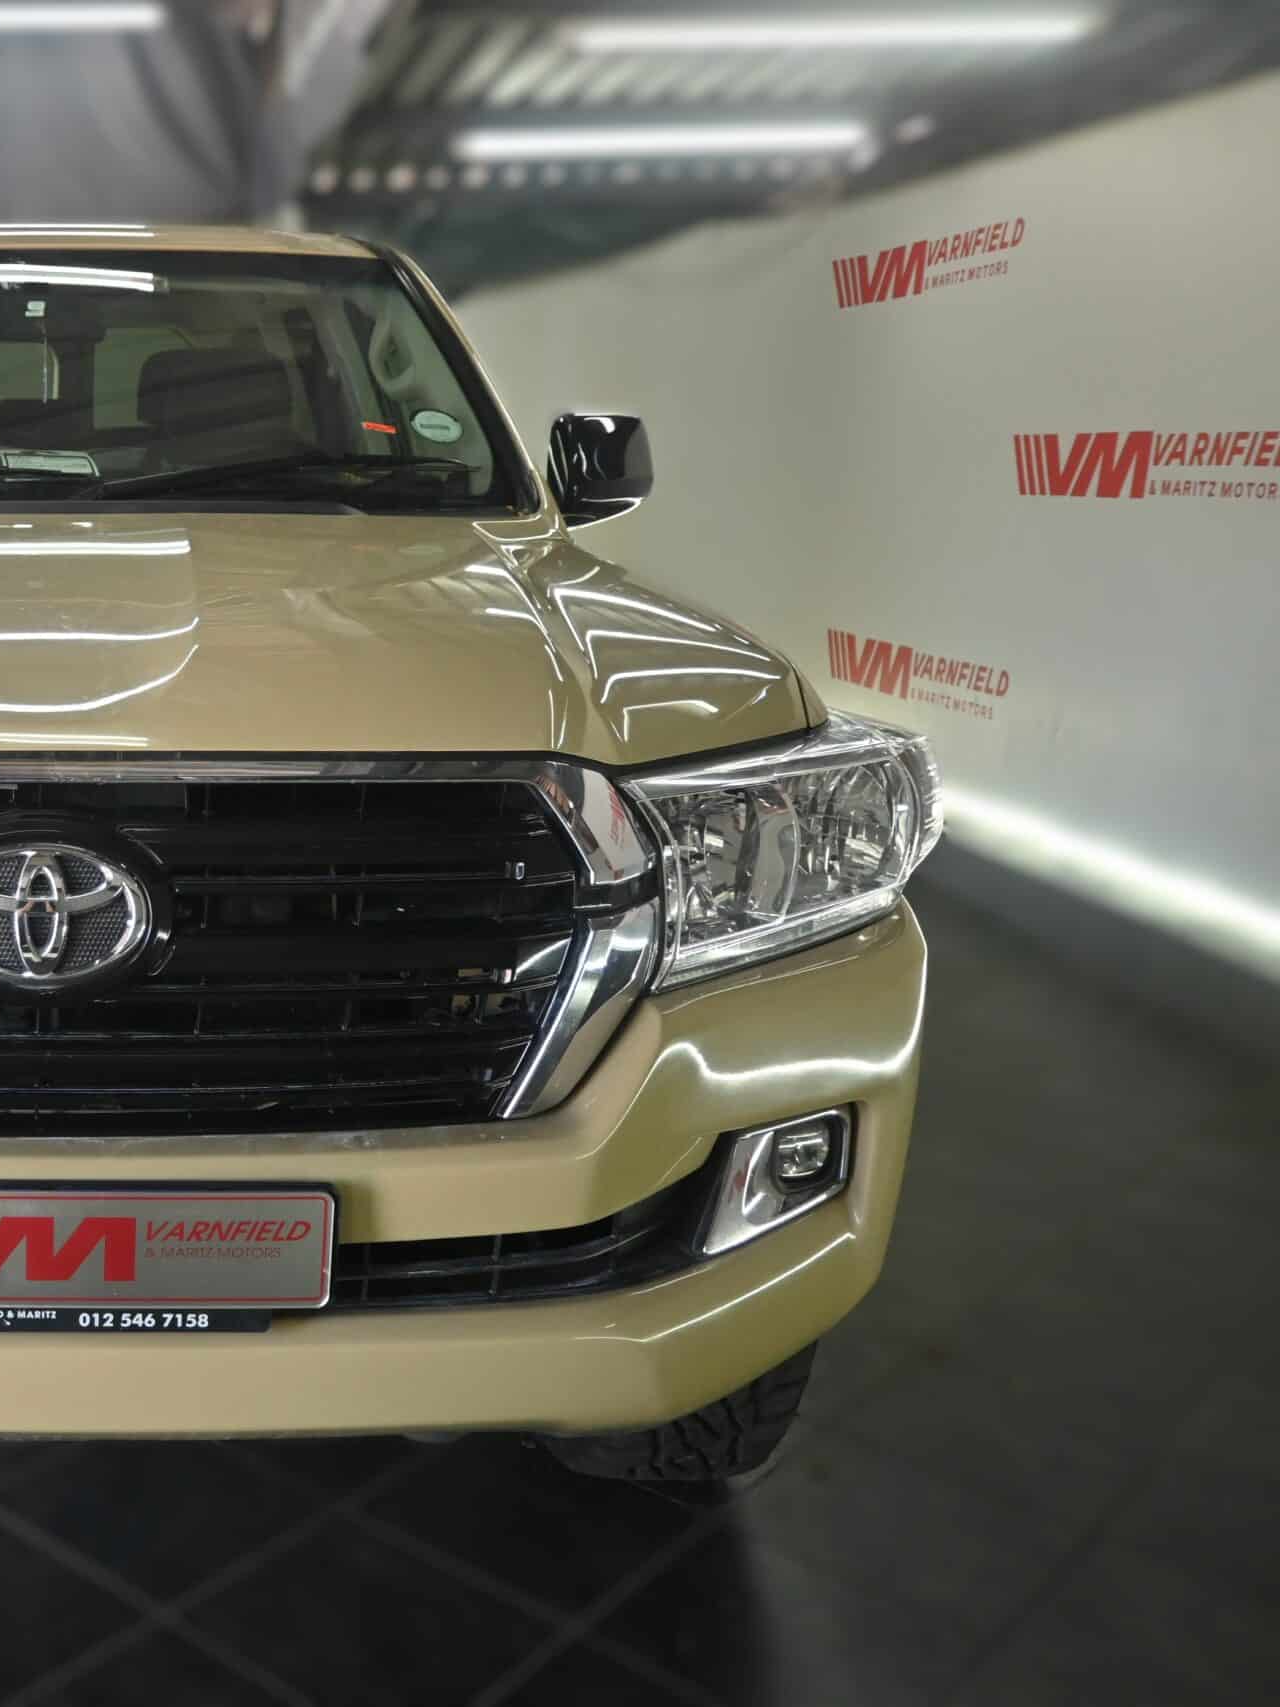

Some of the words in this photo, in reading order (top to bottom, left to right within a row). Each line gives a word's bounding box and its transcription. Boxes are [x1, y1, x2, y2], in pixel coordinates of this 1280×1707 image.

[927, 217, 1025, 267] VARNFIELD
[1161, 480, 1217, 497] MARITZ
[913, 652, 1009, 697] VARNFIELD
[146, 1220, 312, 1242] VARNFIELD
[144, 1248, 155, 1258] &
[160, 1247, 217, 1258] MARITZ
[220, 1247, 281, 1258] MOTORS
[7, 1310, 14, 1319] &
[17, 1310, 57, 1319] MARITZ
[78, 1312, 114, 1327] 012
[120, 1313, 156, 1328] 546
[162, 1313, 209, 1328] 7158
